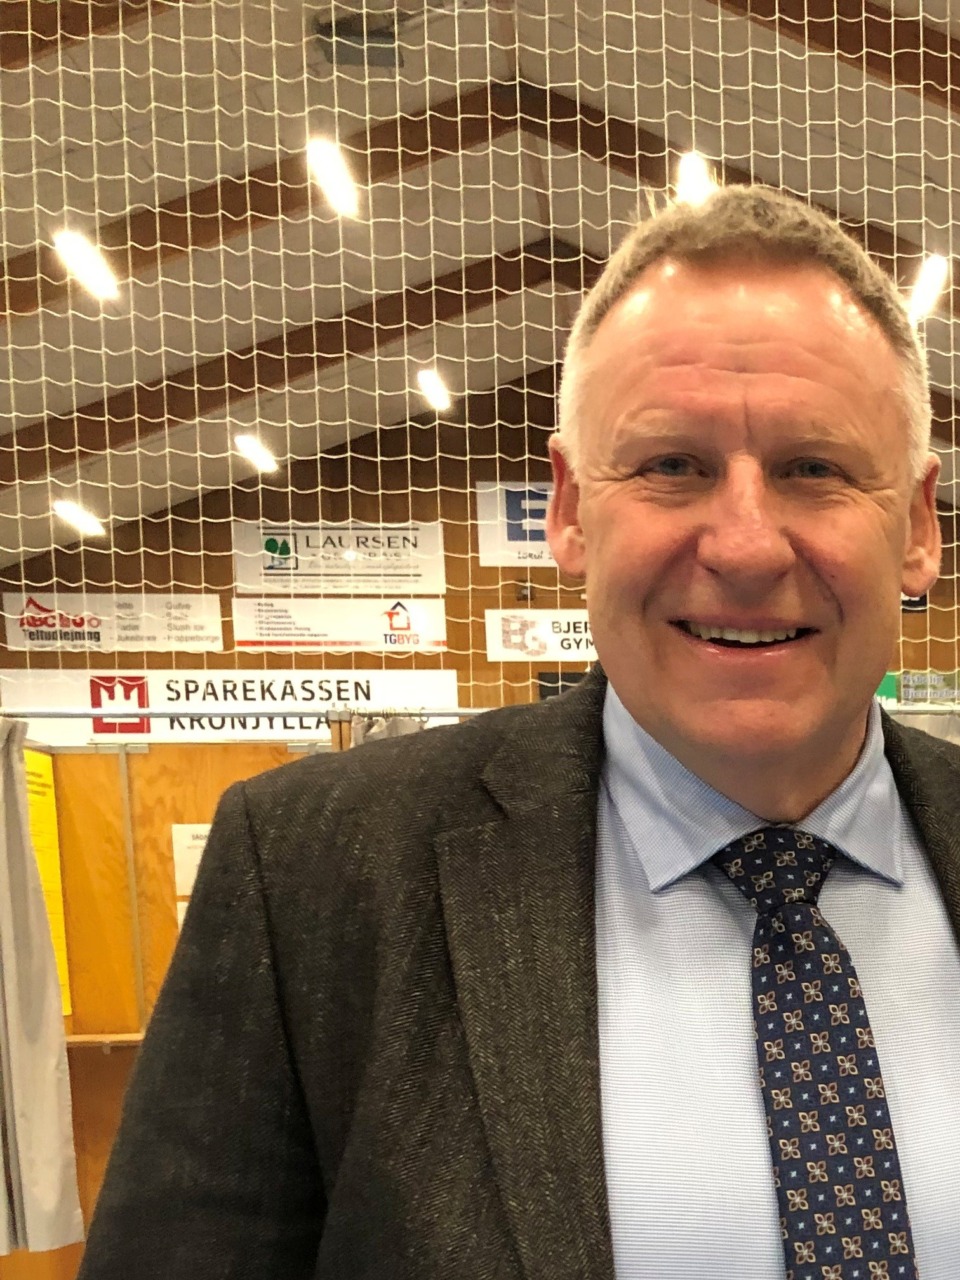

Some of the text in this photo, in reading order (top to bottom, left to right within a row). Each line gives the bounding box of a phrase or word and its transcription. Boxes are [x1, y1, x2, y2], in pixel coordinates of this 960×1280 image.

[305, 535, 418, 549] LAURSEN
[383, 633, 420, 645] TGBYG
[165, 679, 372, 702] SPAREKASSEN
